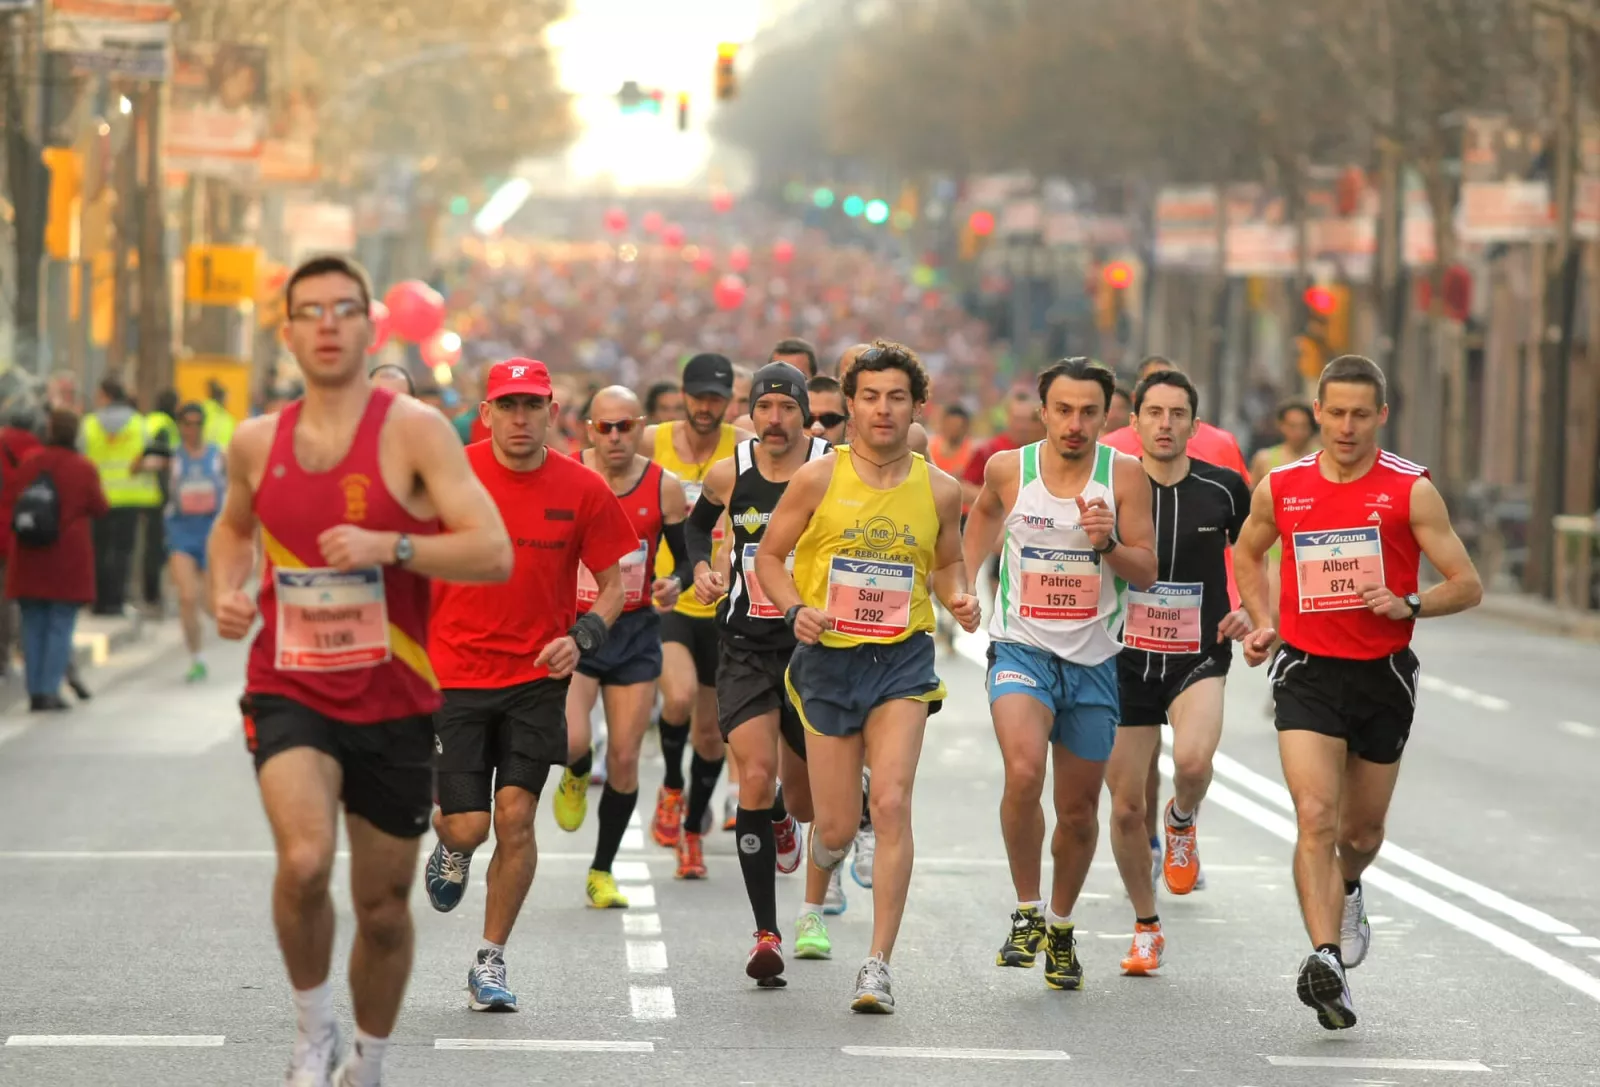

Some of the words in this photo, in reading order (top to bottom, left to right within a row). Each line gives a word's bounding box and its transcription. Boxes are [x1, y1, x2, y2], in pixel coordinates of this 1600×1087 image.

[855, 550, 900, 560] REBOLLAR
[1322, 559, 1359, 572] Albert
[1040, 575, 1082, 587] Patrice
[1330, 578, 1355, 592] 874
[858, 589, 884, 602] Saul
[1046, 594, 1076, 606] 1575
[854, 608, 884, 622] 1292
[1147, 608, 1180, 620] Daniel
[1149, 625, 1178, 639] 1172
